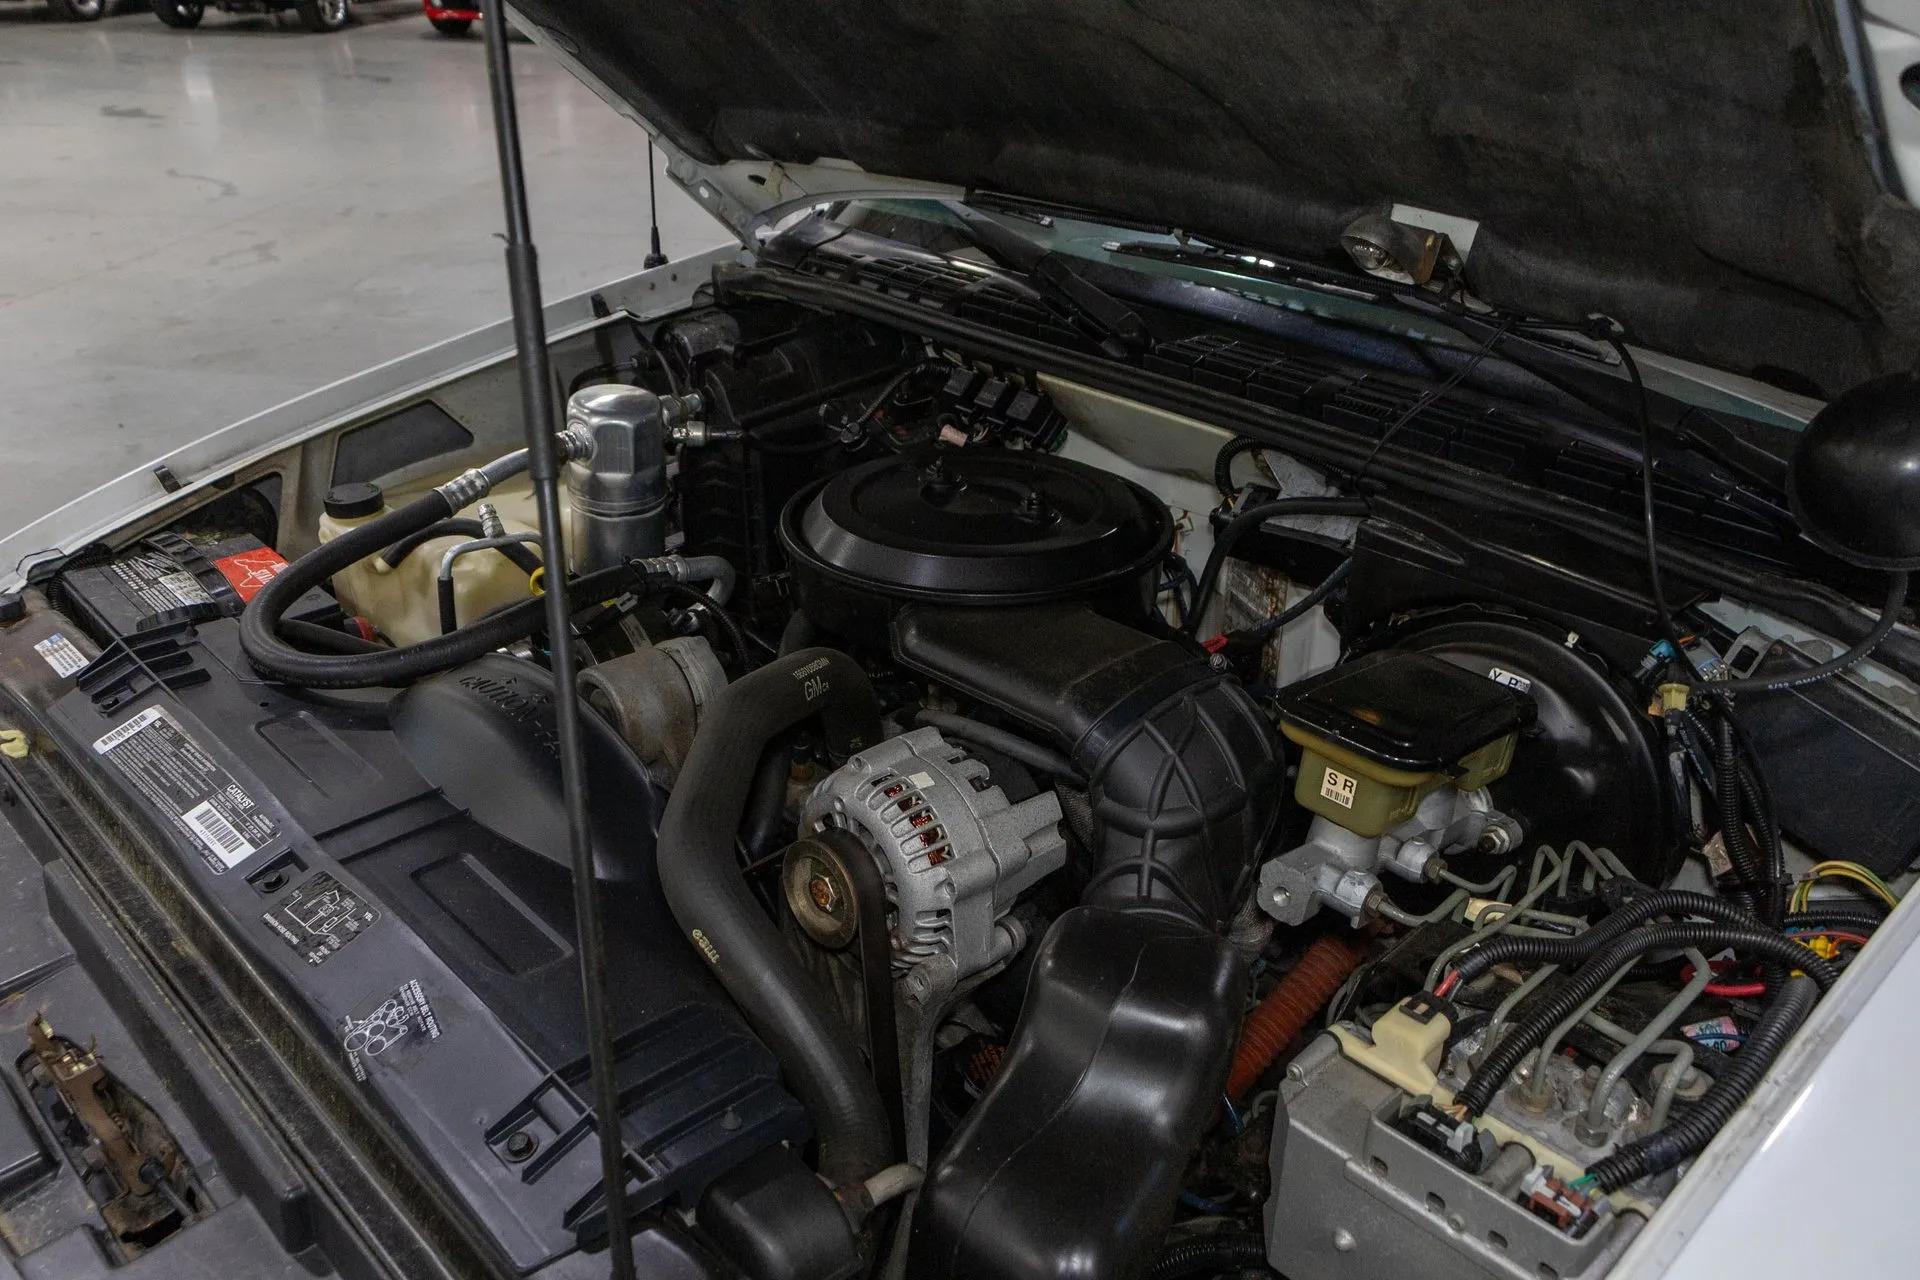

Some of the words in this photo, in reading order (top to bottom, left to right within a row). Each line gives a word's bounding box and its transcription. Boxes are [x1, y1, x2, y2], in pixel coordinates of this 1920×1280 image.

[1493, 670, 1501, 687] Y
[1507, 676, 1518, 690] P
[1327, 772, 1338, 786] S
[1342, 778, 1354, 795] R
[227, 784, 255, 809] CATALYST
[409, 979, 426, 1005] ACCESSORY
[420, 1004, 431, 1017] BELT
[426, 1016, 440, 1039] ROUTING
